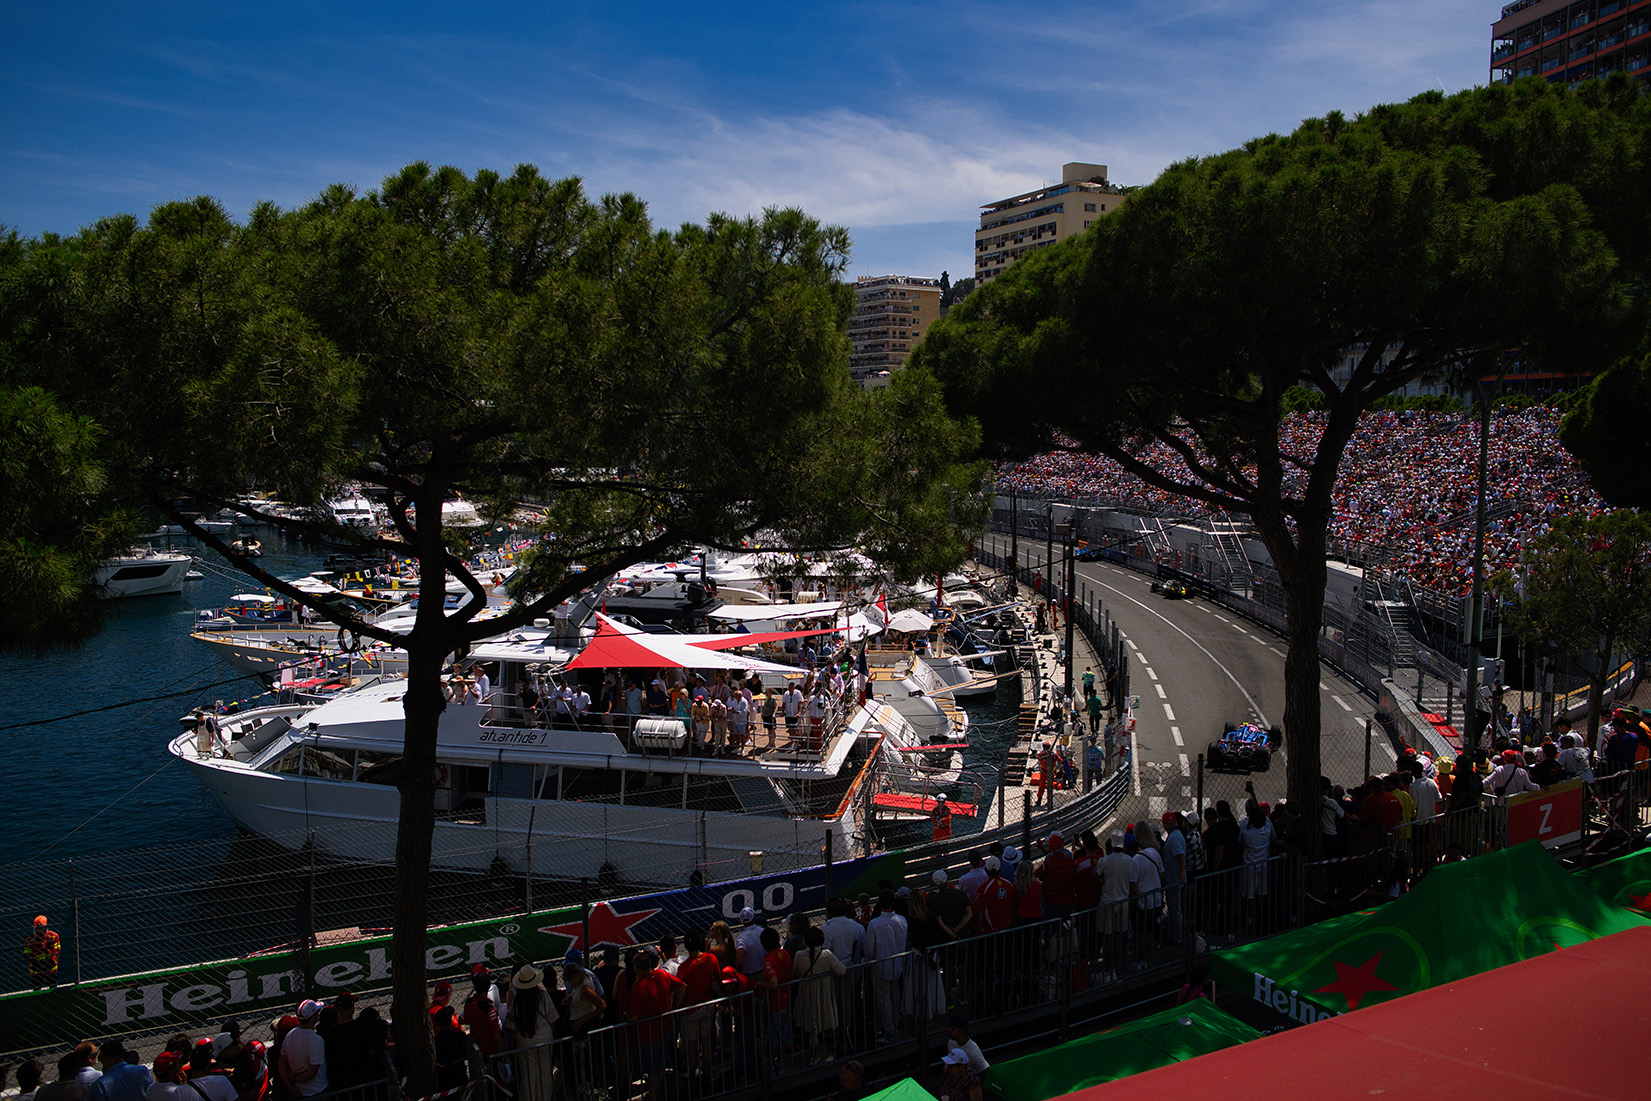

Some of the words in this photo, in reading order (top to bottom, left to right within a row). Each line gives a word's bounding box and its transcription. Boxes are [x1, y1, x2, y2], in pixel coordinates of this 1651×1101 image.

[480, 729, 538, 744] atlantide
[540, 732, 548, 744] 1
[1538, 803, 1553, 835] Z
[1253, 972, 1344, 1025] Hein
